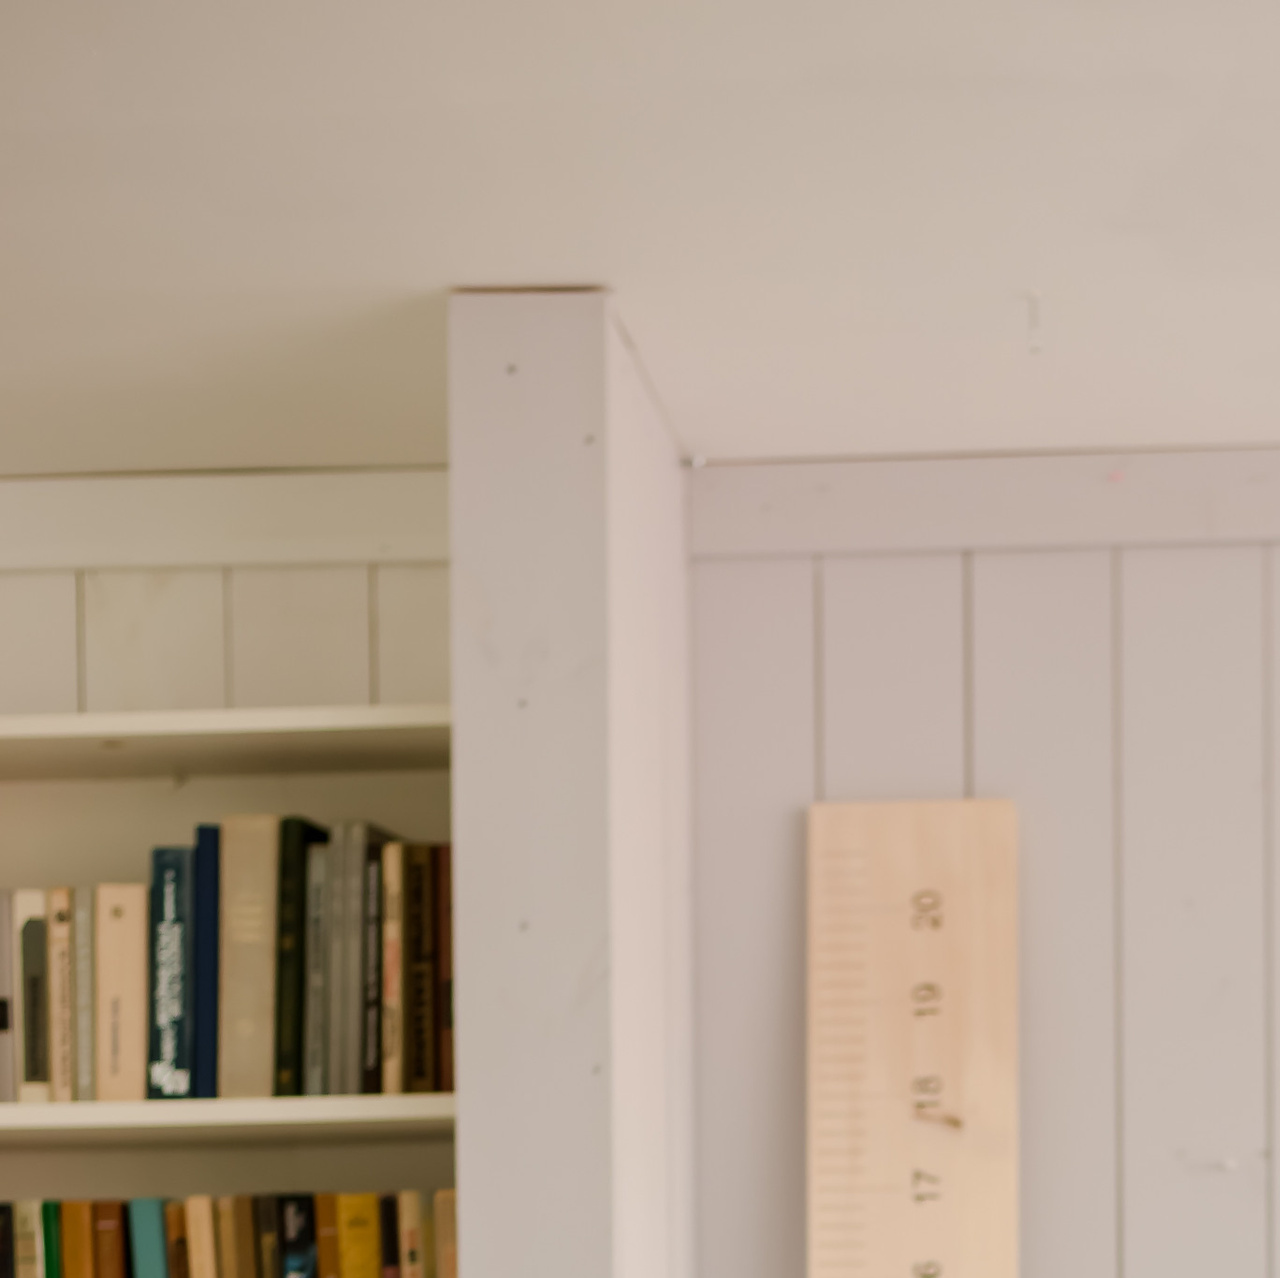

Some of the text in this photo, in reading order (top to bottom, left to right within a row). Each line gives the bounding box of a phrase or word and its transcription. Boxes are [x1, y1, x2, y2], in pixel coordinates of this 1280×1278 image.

[911, 889, 943, 931] 20
[911, 982, 942, 1018] 19
[911, 1075, 942, 1109] 18
[911, 1169, 941, 1204] 17
